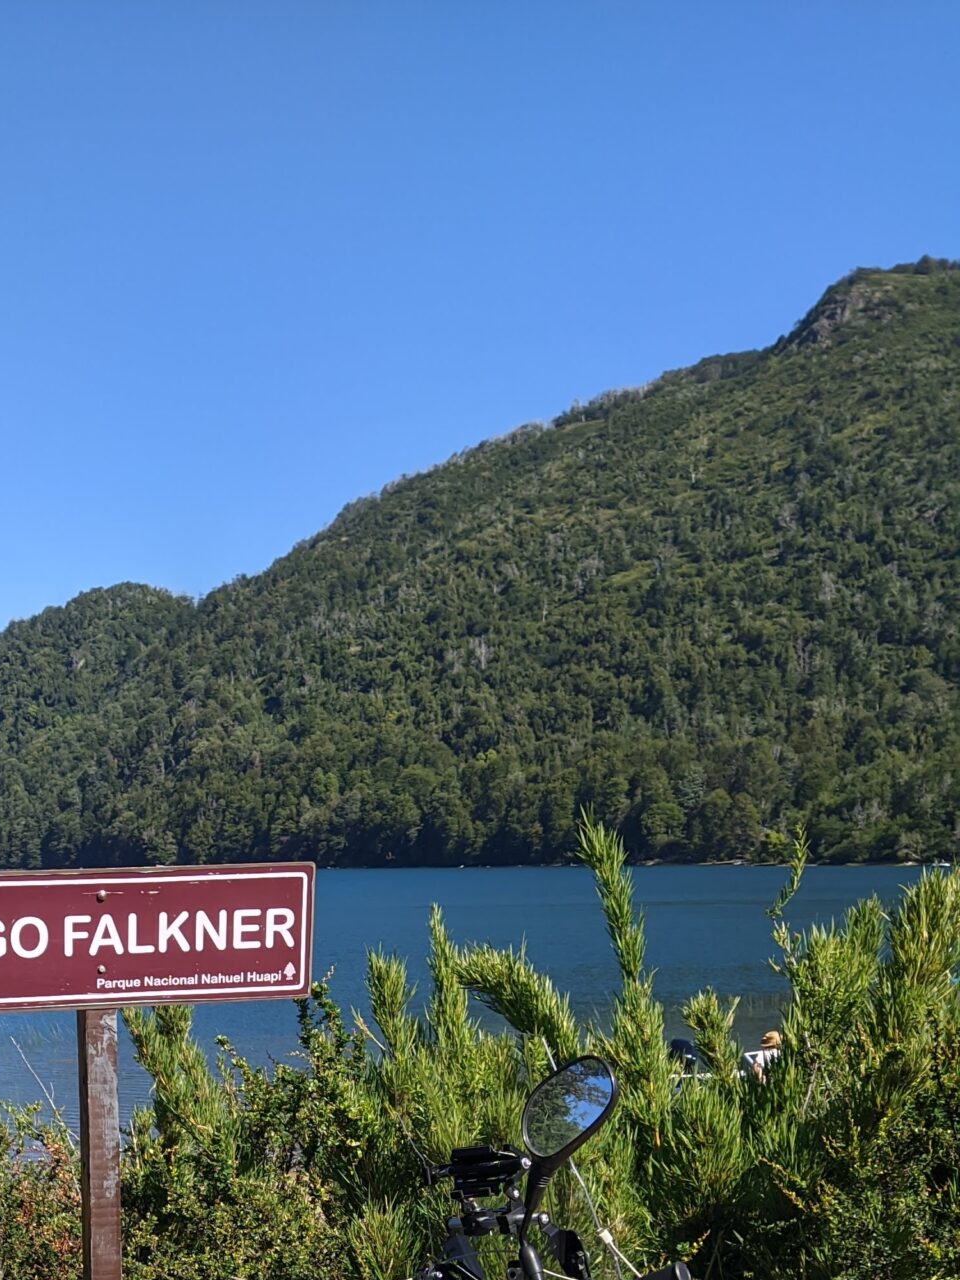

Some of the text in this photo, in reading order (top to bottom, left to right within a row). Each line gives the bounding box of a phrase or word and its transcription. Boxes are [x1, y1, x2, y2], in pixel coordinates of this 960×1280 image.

[63, 907, 296, 958] FALKNER
[96, 969, 282, 991] Parque Nacional Nahuel Huapi
